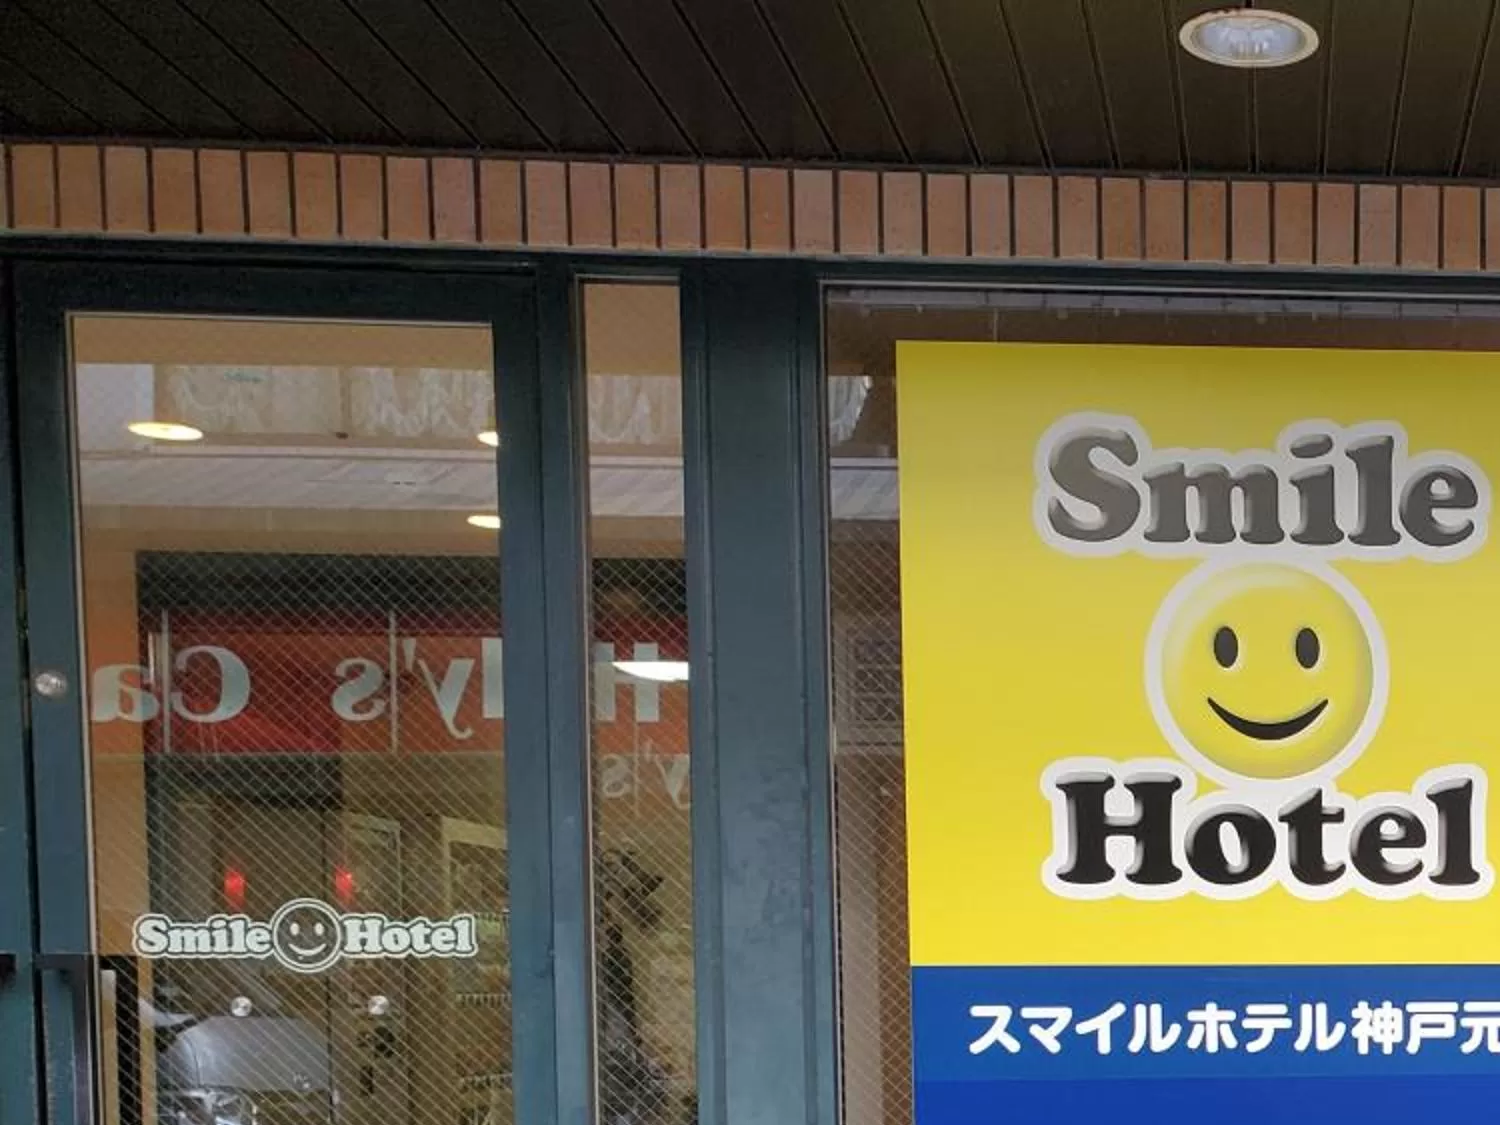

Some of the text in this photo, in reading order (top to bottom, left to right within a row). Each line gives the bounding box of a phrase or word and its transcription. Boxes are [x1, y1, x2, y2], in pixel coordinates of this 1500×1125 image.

[1047, 426, 1478, 547] Smile
[1054, 771, 1480, 887] Hotel
[136, 917, 475, 956] Smile Hotel
